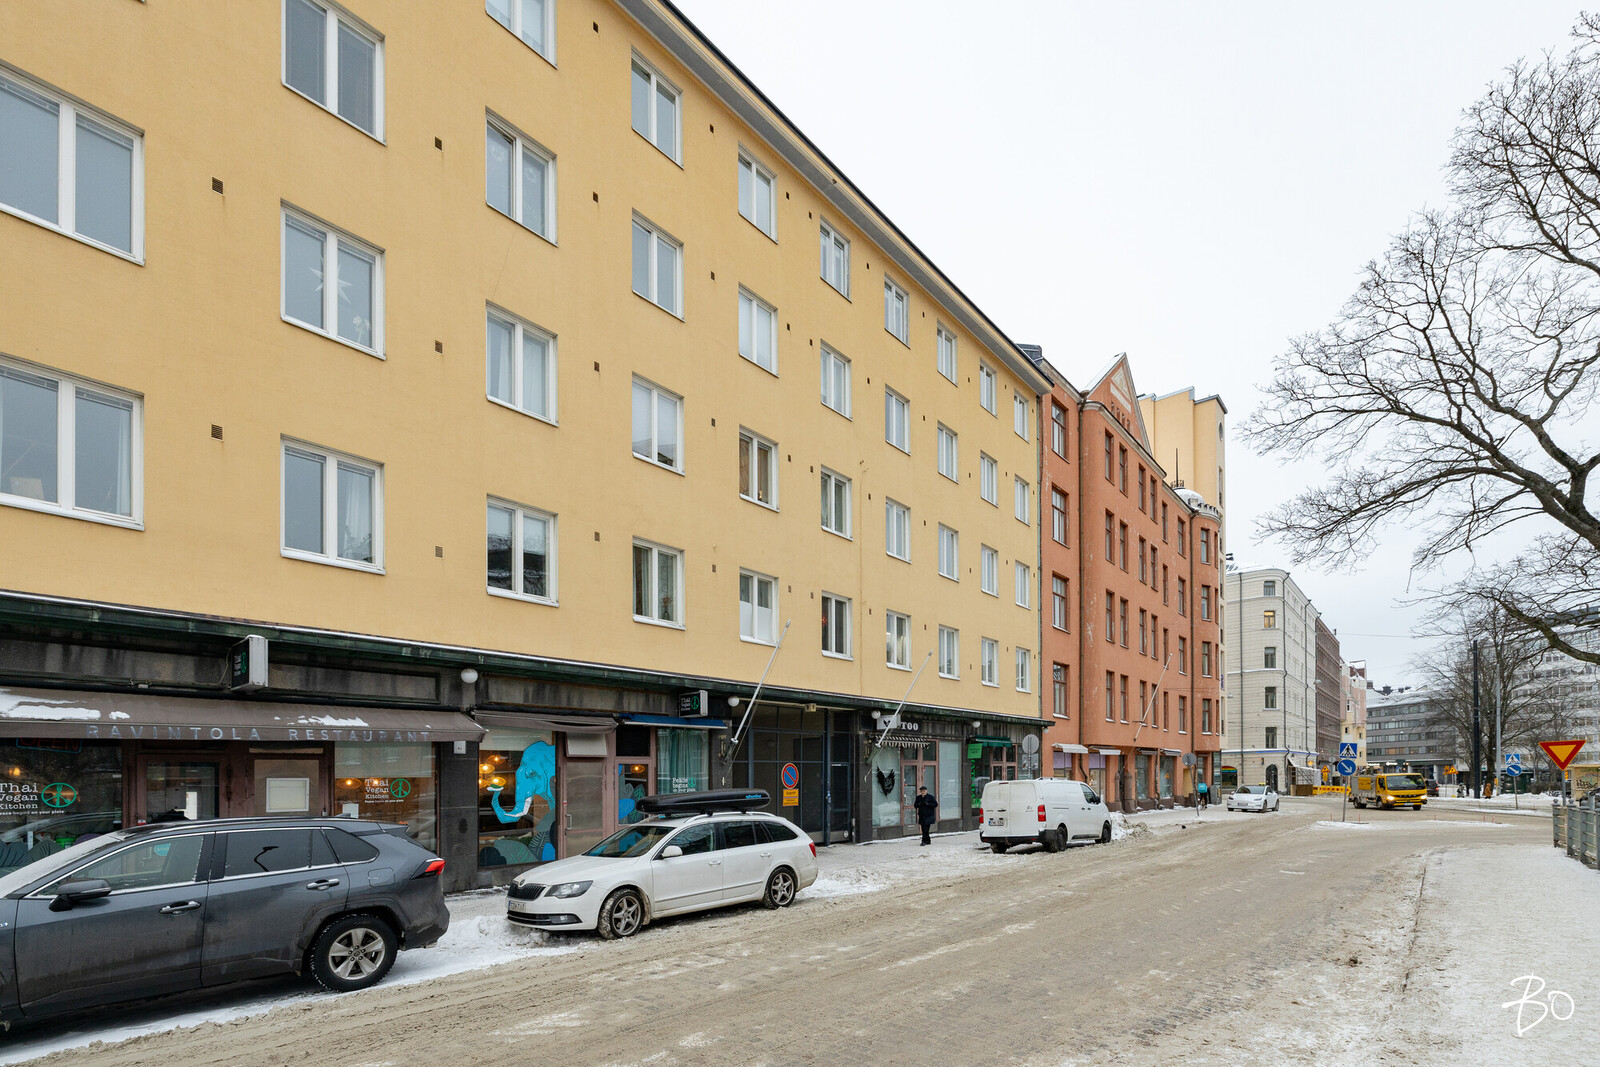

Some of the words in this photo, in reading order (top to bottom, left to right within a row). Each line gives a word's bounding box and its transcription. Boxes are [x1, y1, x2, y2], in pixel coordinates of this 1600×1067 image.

[86, 725, 261, 740] RAVINTOLA
[288, 729, 430, 742] RESTAURANT
[0, 782, 39, 793] Thai
[365, 786, 389, 794] Vegan
[0, 793, 39, 802] Vegan
